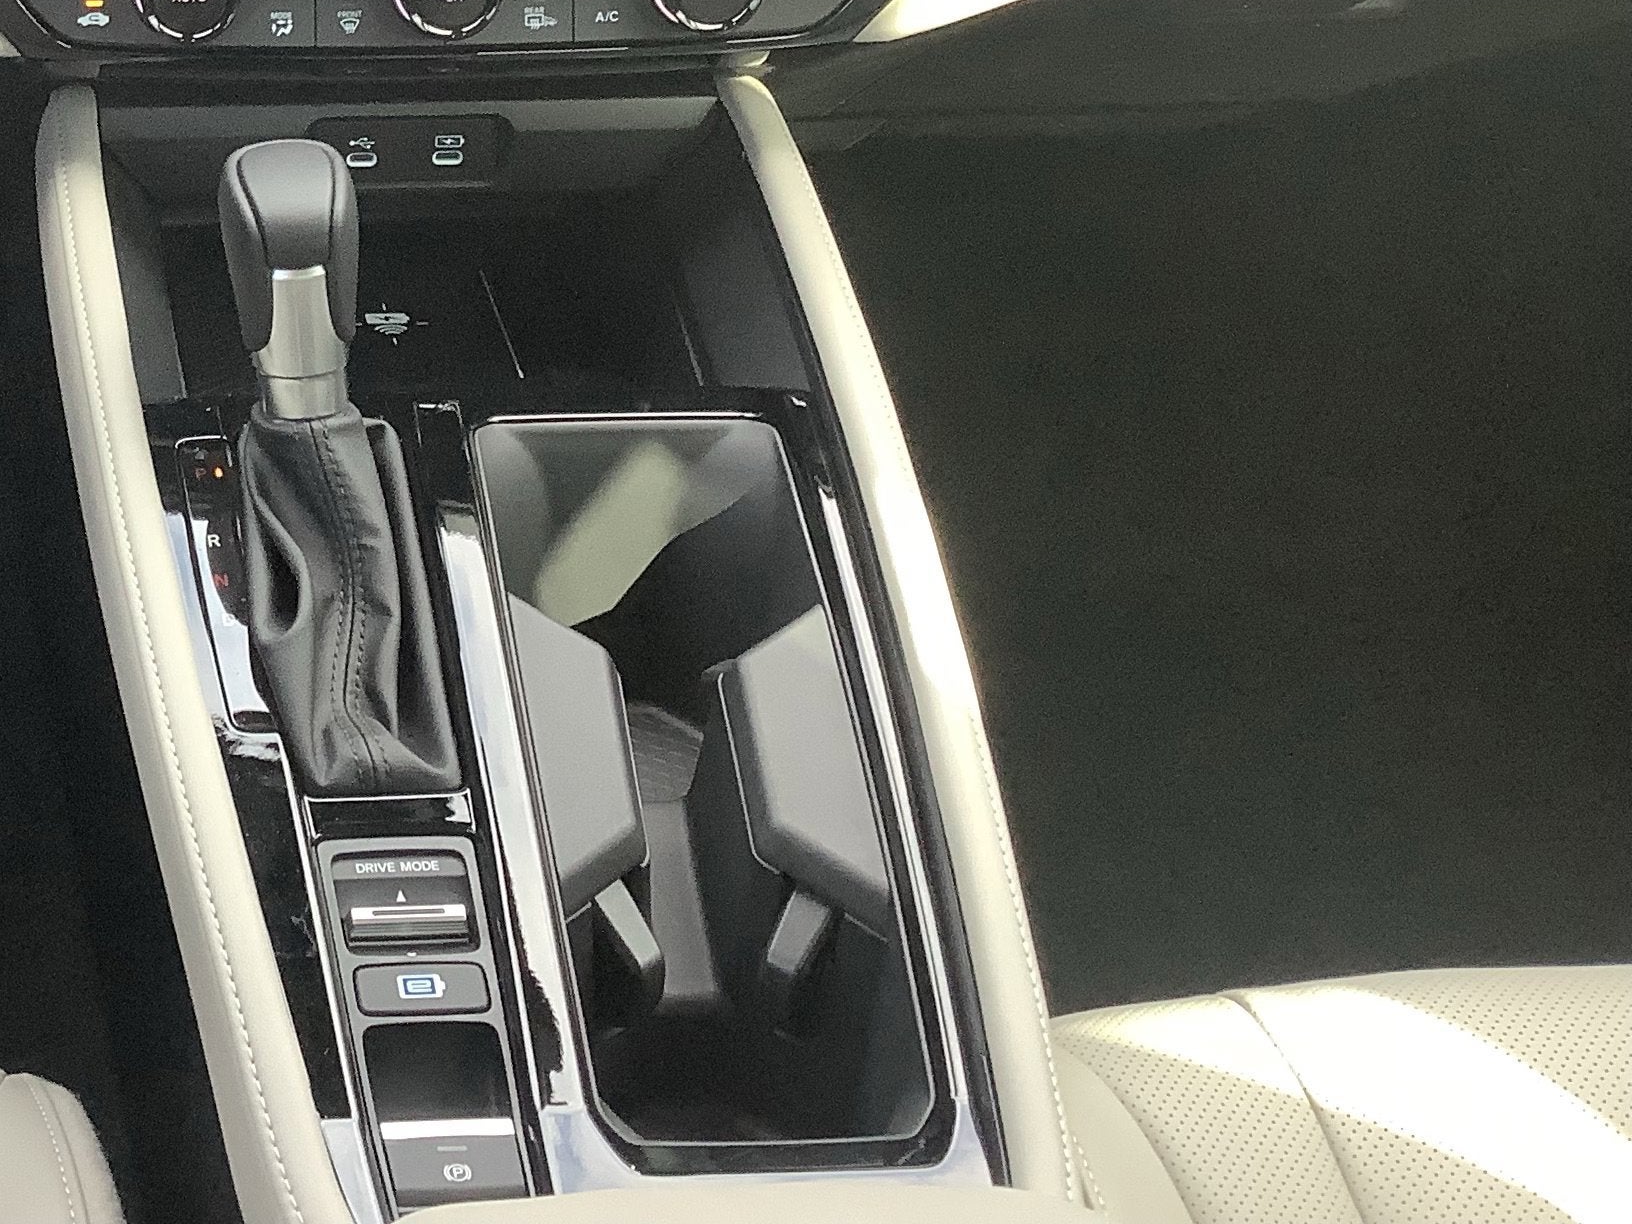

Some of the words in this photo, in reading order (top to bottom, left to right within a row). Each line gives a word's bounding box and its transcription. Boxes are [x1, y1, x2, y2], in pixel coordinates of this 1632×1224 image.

[595, 10, 619, 23] A/C
[207, 534, 222, 548] R
[213, 573, 229, 587] N
[355, 862, 396, 875] DRIVE
[400, 860, 440, 873] MODE
